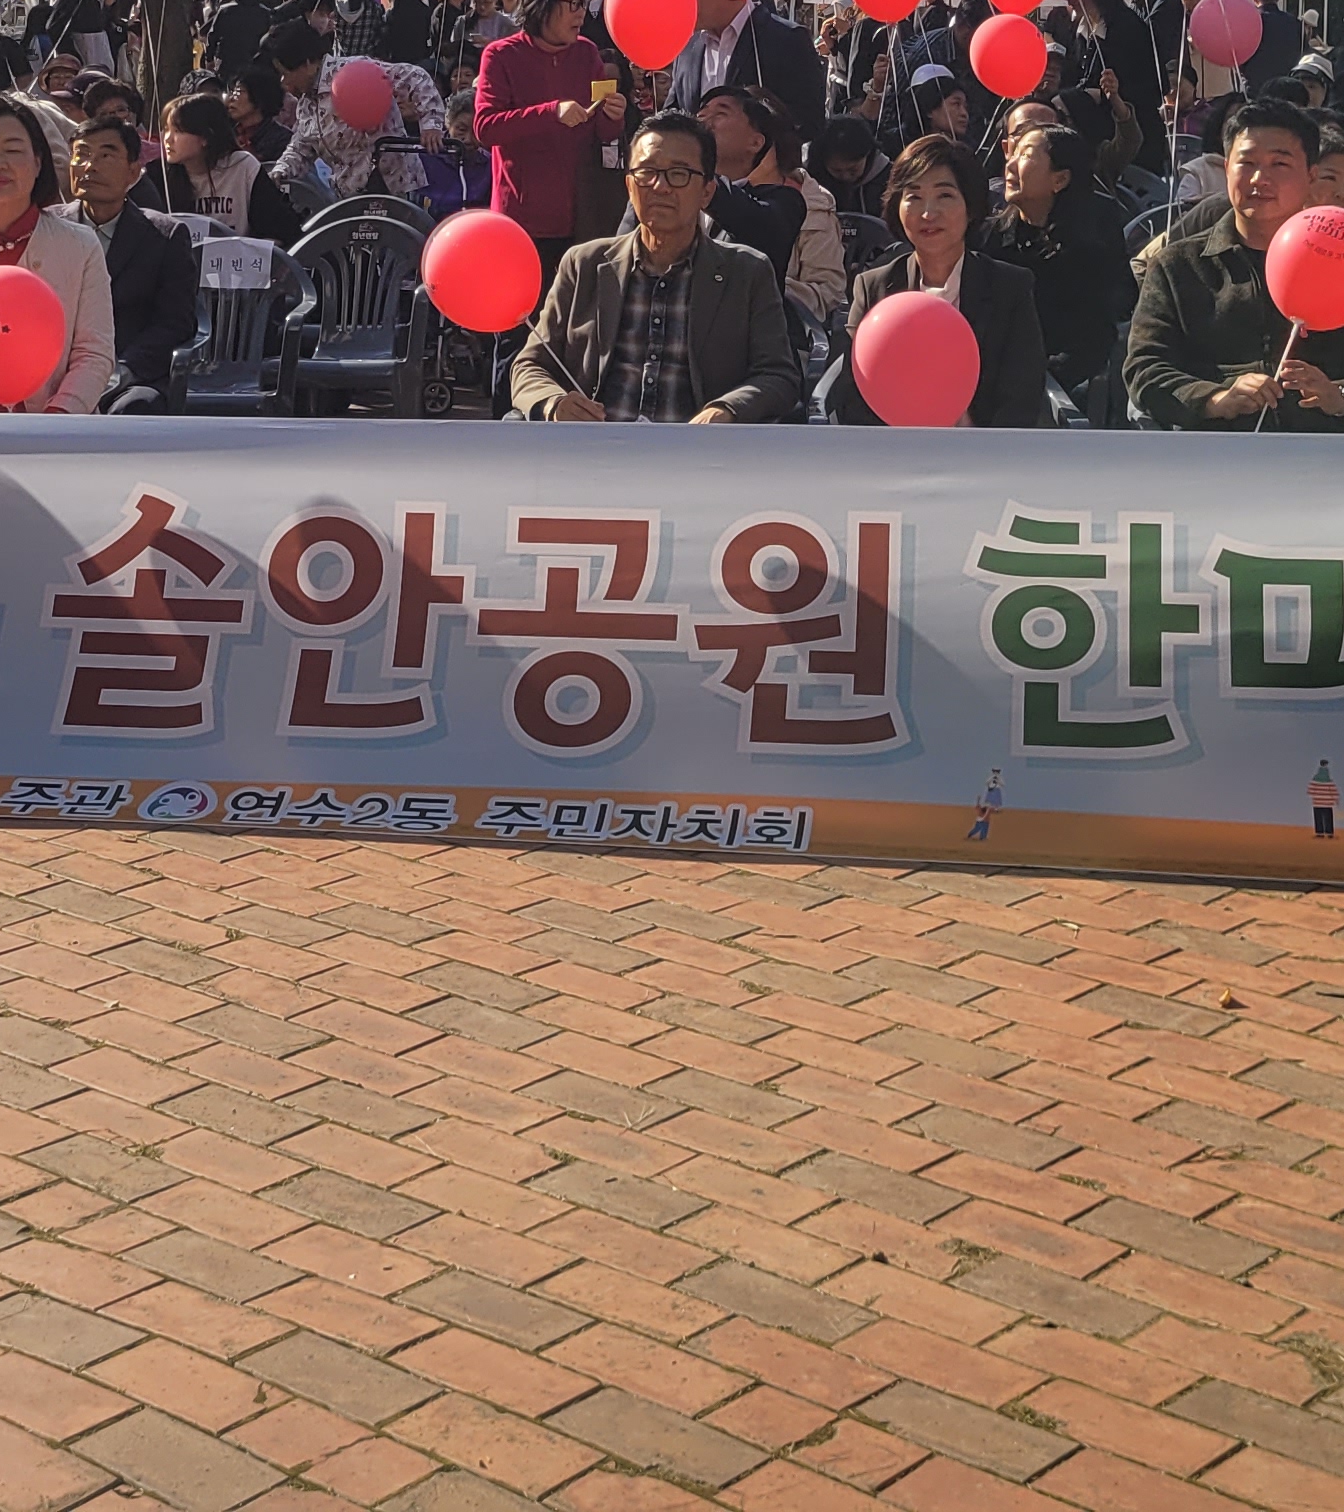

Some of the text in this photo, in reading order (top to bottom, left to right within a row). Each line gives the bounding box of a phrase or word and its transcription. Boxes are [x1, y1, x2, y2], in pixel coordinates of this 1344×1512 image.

[50, 492, 899, 749] 솔안공원
[2, 779, 808, 850] 주관 연수2동 주민자치회
